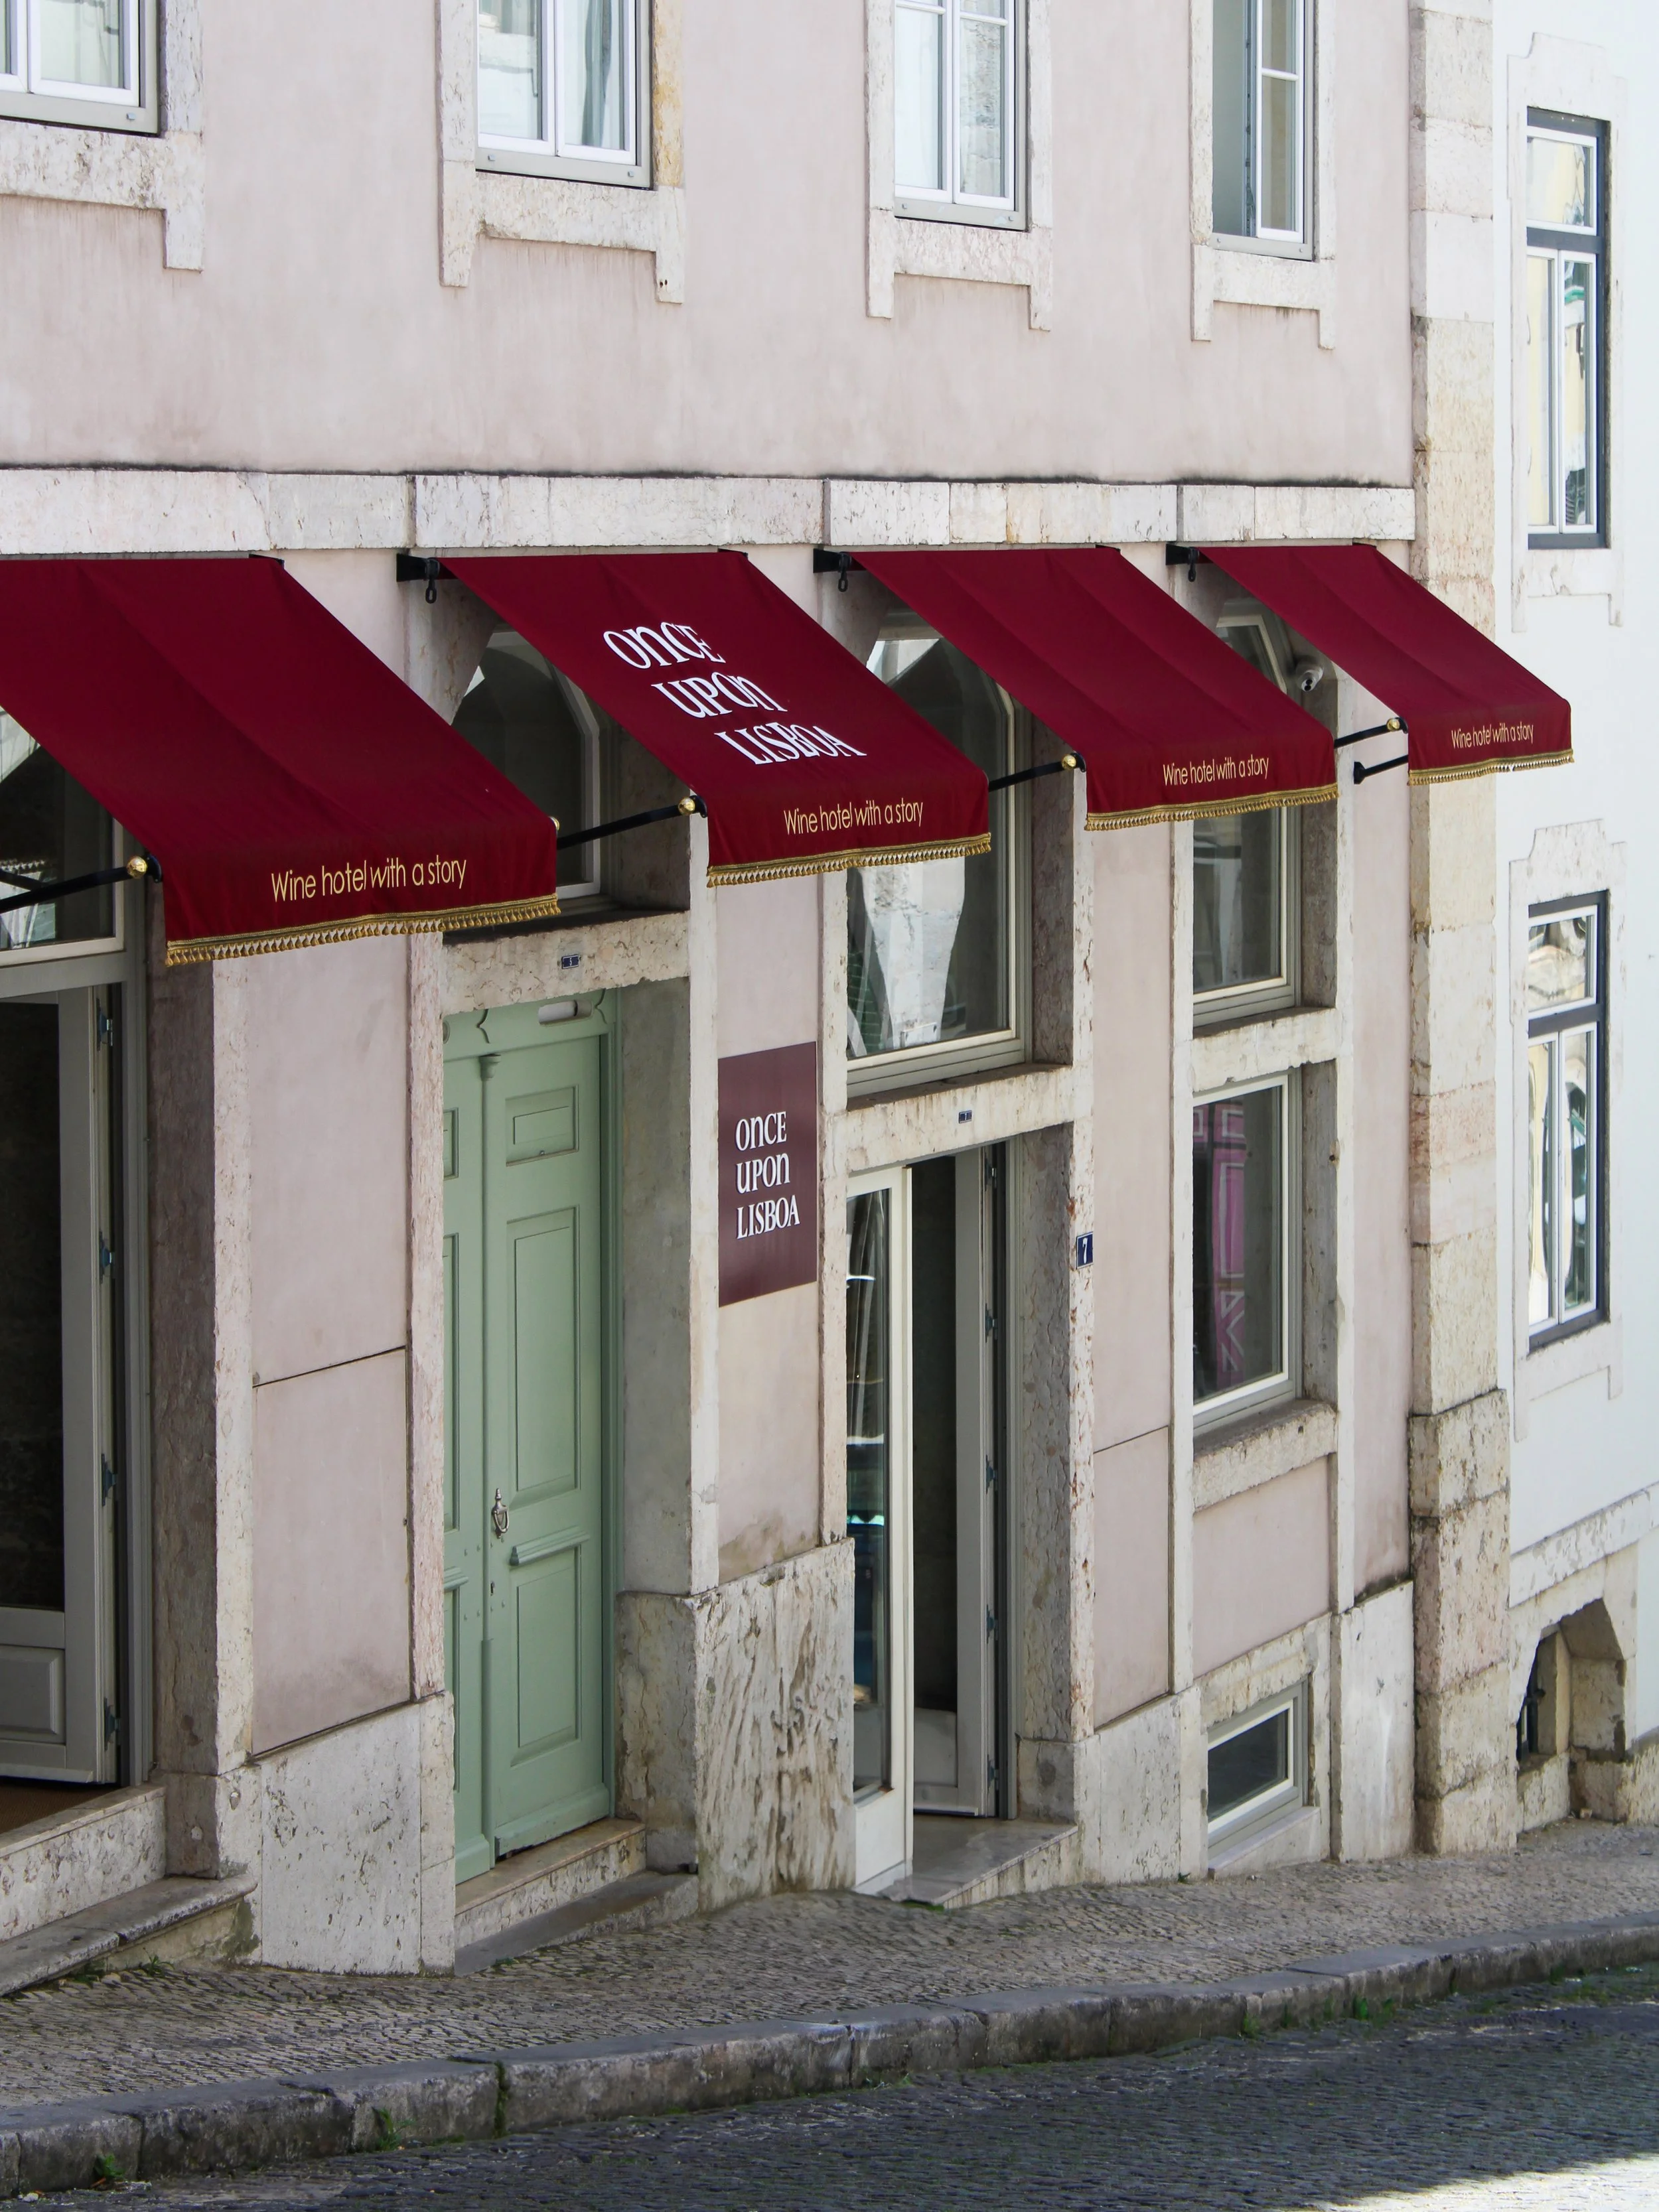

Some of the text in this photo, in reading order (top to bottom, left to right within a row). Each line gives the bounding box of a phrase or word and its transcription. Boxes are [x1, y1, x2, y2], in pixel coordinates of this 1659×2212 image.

[714, 722, 867, 765] LISBOA
[1451, 728, 1472, 749] Wine
[1473, 724, 1492, 746] hotel
[1492, 722, 1510, 743] with
[1517, 721, 1534, 744] story
[1163, 754, 1269, 786] Wine hotel with a story
[784, 797, 924, 835] Wine hotel with a story
[271, 855, 467, 902] Wine hotel with a story
[737, 1194, 800, 1239] LISBOA
[1082, 1237, 1088, 1264] 7
